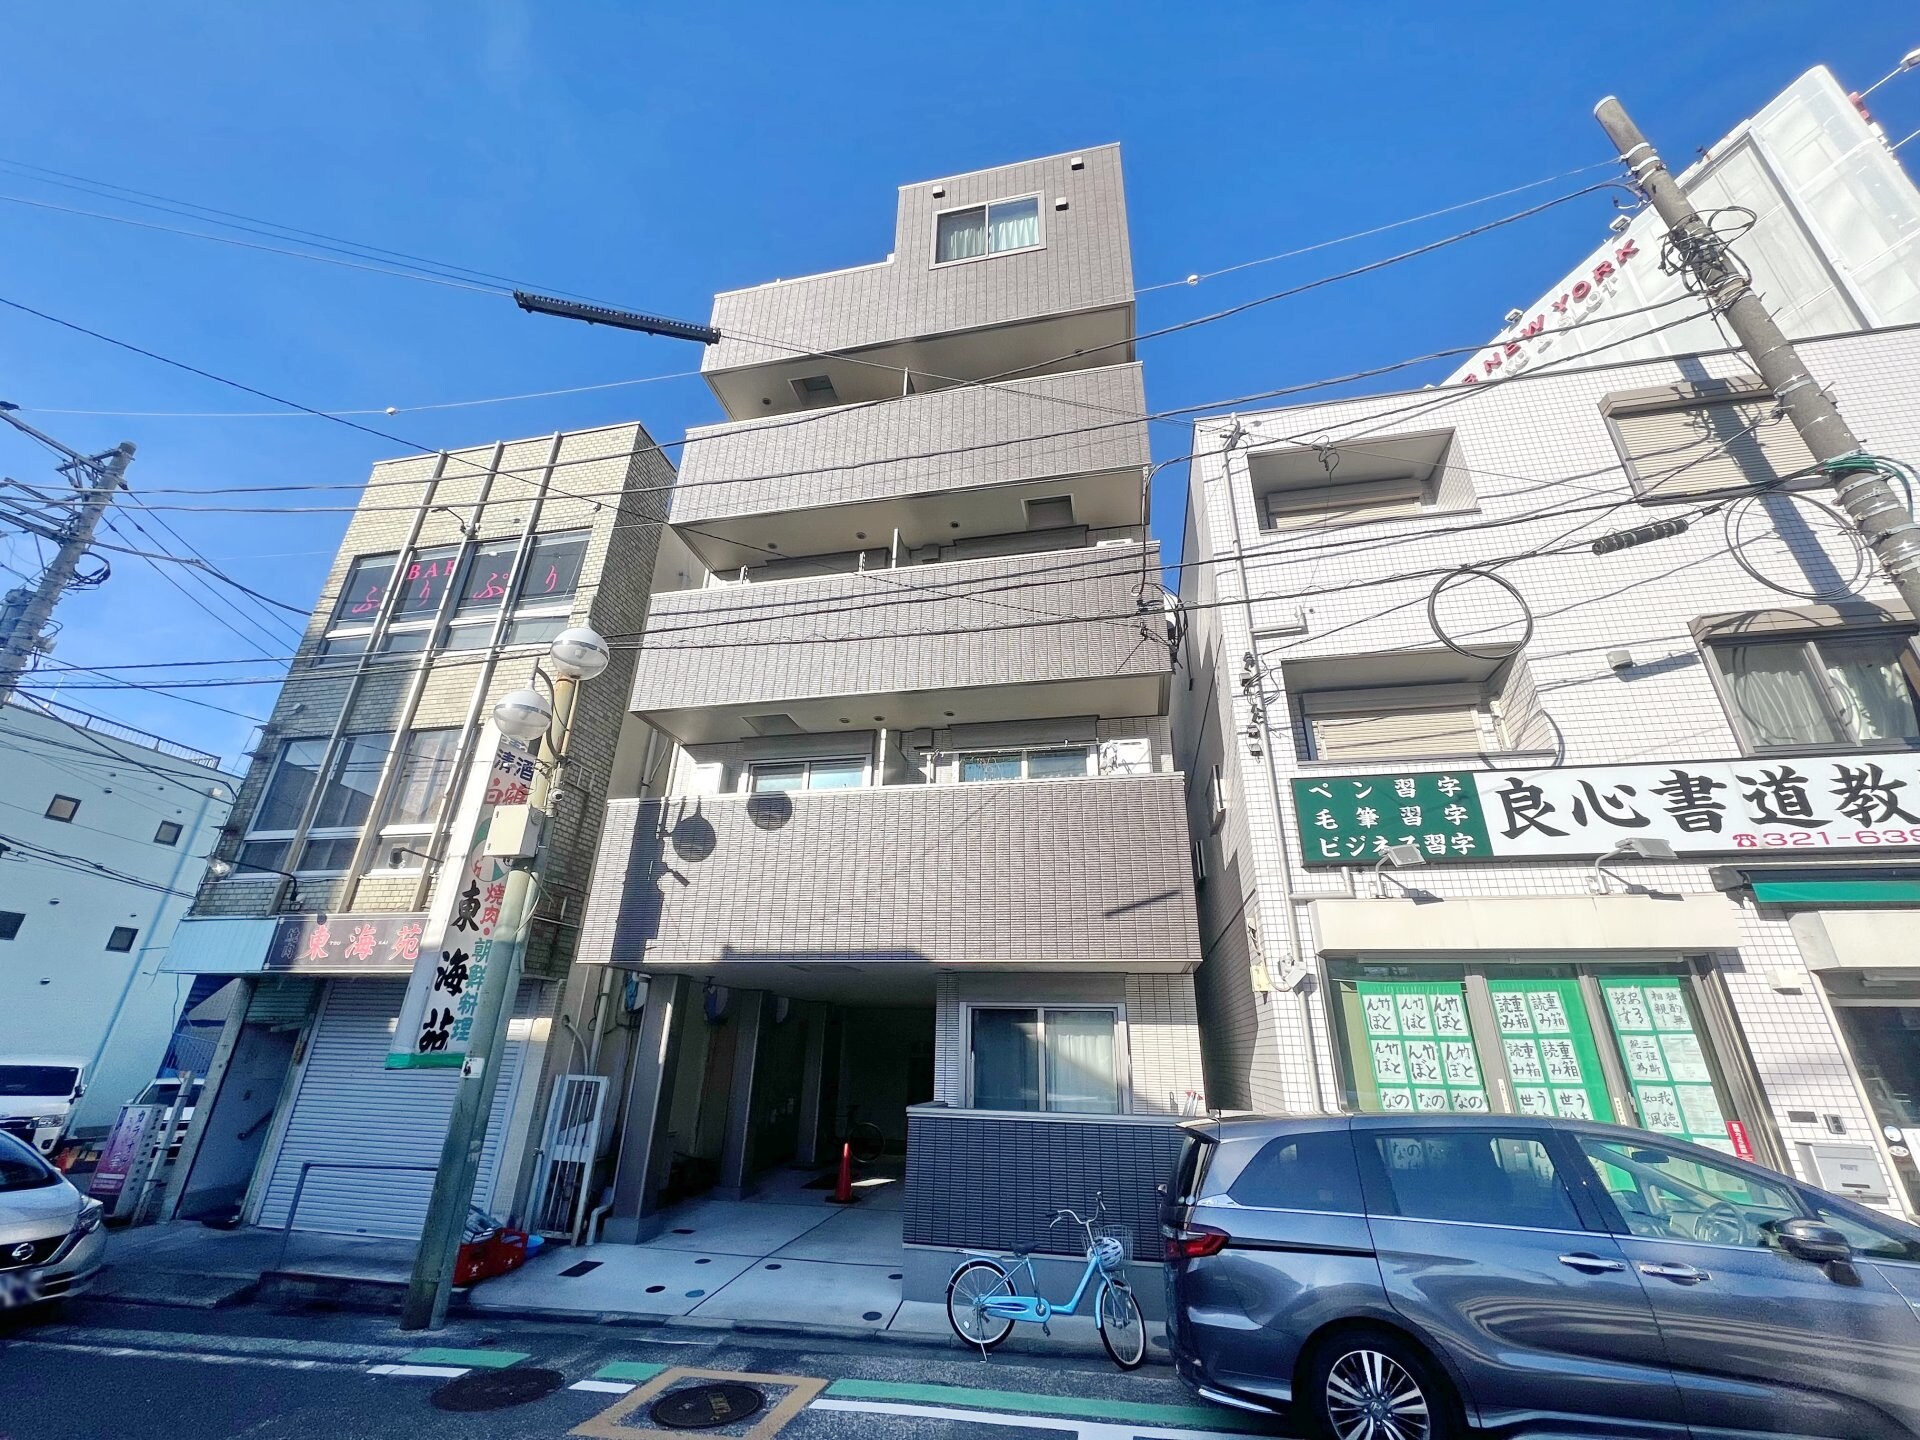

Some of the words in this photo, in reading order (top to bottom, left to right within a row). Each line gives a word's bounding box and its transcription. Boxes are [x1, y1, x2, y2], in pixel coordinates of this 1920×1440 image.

[1552, 238, 1640, 314] YORK
[494, 748, 534, 782] 清酒
[1308, 775, 1462, 799] ペン習字
[1495, 763, 1920, 840] 良心書道教
[1314, 803, 1469, 830] 毛筆習字
[294, 923, 422, 961] 東海苑
[418, 879, 481, 1053] 東海苑
